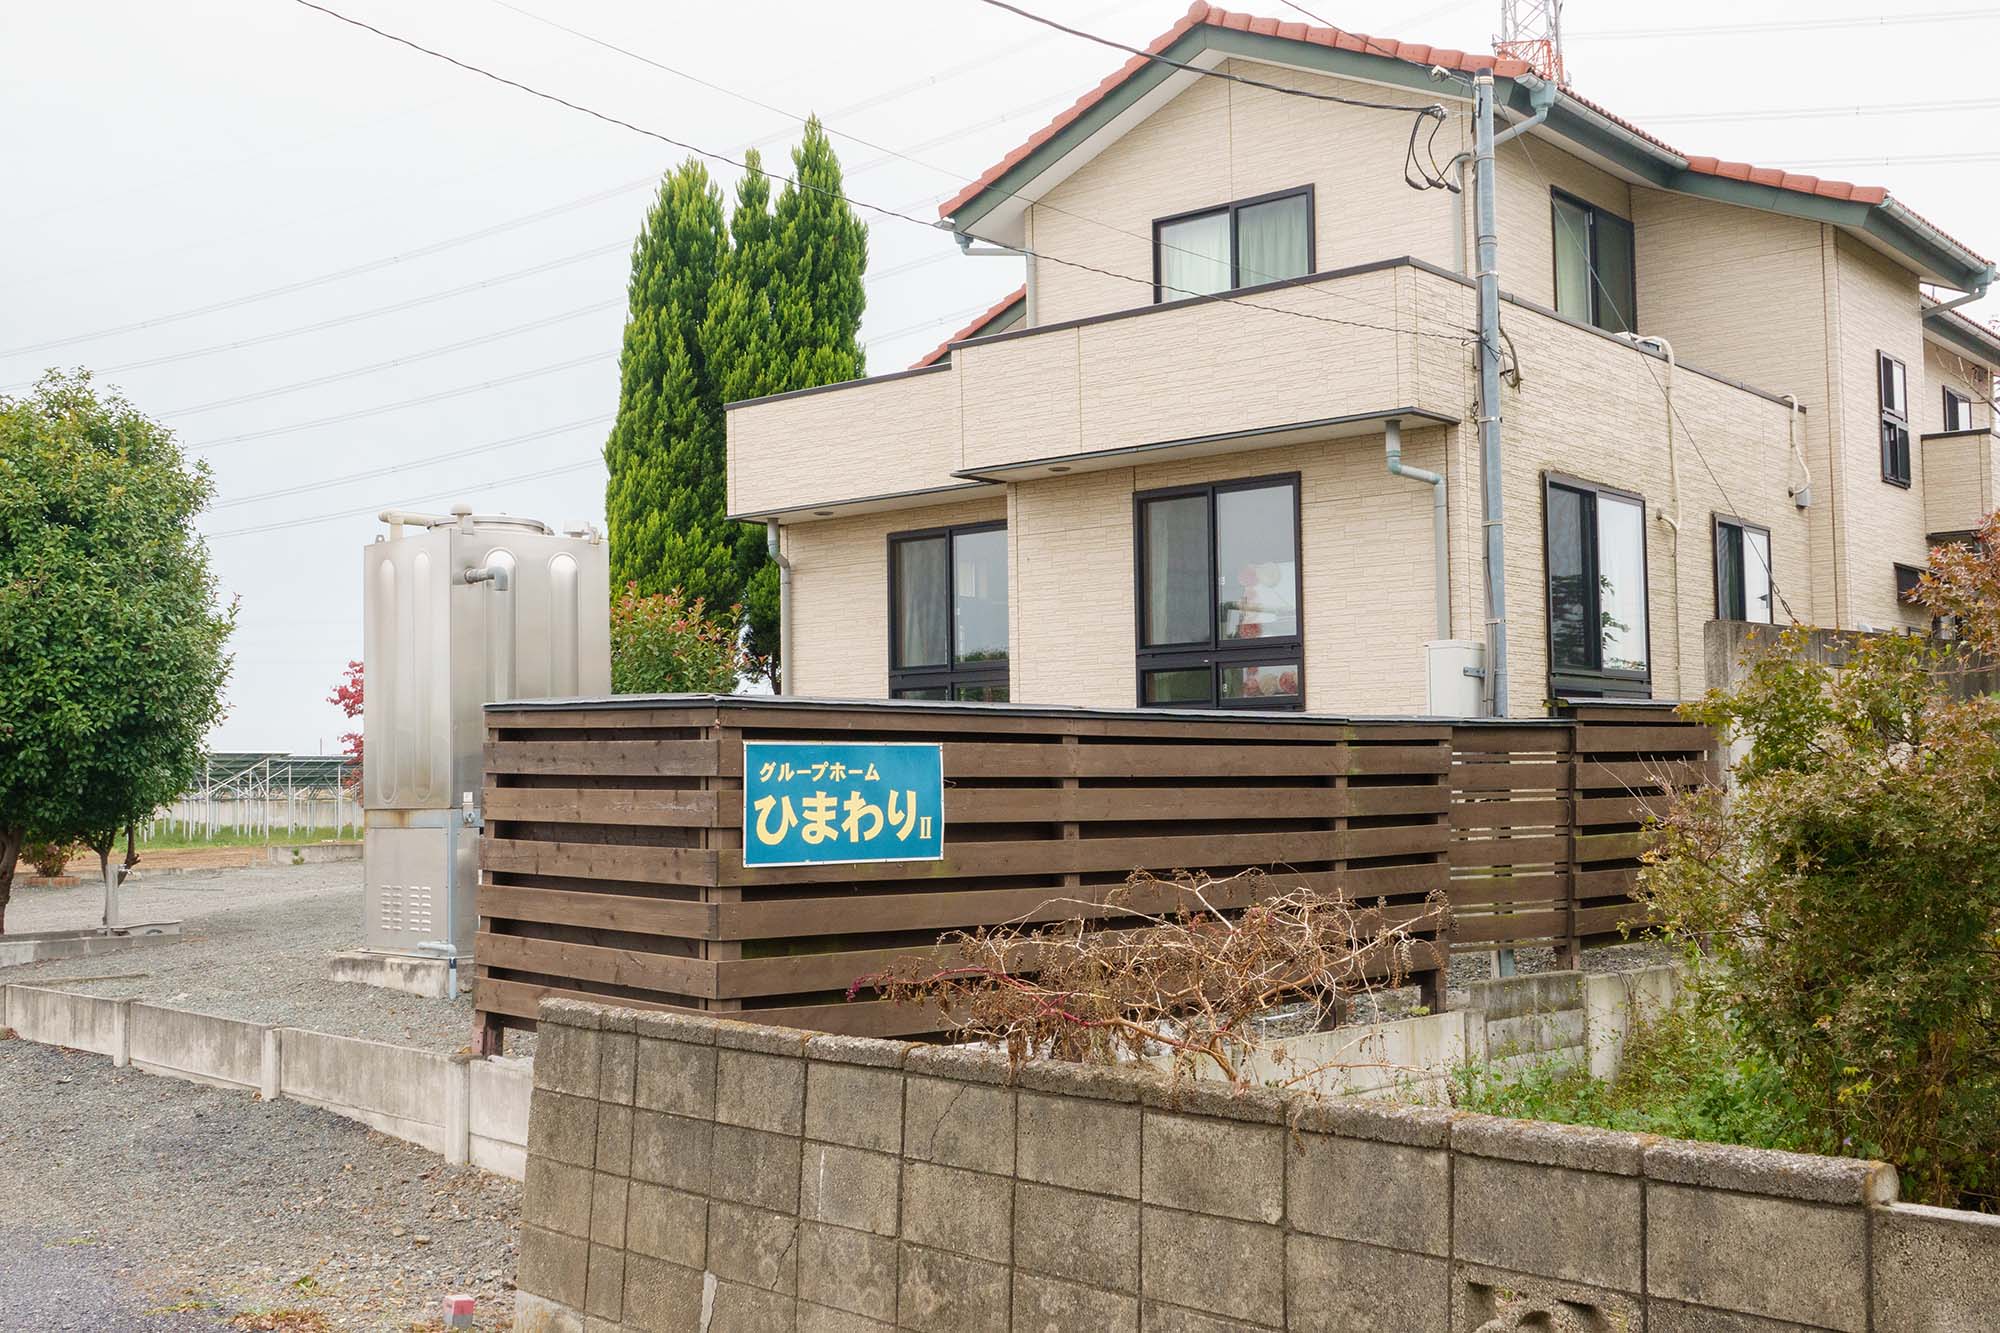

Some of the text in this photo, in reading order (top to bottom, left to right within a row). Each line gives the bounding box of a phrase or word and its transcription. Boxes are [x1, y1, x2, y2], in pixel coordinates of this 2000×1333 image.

[759, 761, 880, 782] グループホーム
